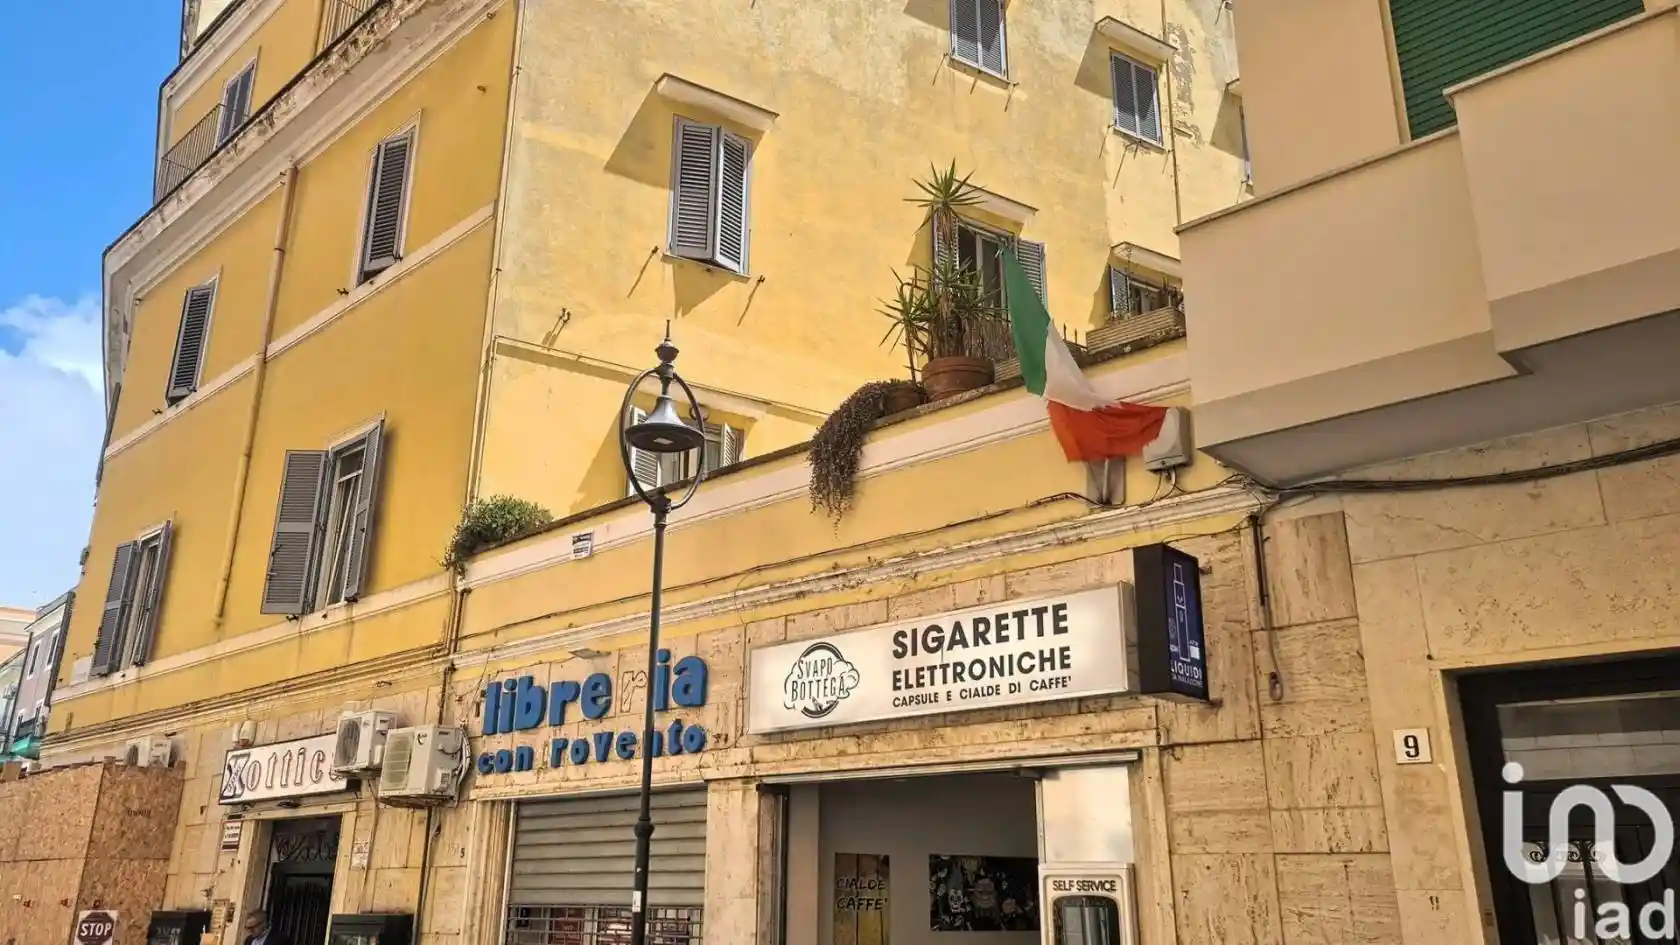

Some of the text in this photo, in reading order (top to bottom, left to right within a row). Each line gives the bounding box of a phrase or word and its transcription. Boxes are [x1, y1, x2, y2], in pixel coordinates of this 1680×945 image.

[892, 602, 1068, 659] SIGARETTE
[797, 657, 833, 680] SVAPO
[892, 646, 1071, 691] ELETTRONICHE
[1170, 660, 1202, 680] LIQUIDI
[791, 676, 846, 701] BOTTEGA
[892, 675, 1072, 708] CAPSULE E CIALDE DI CAFFE'
[1403, 734, 1420, 758] 9
[477, 745, 535, 775] con
[836, 878, 886, 890] CIALDE
[1052, 879, 1118, 893] SELF SERVICE
[836, 896, 888, 911] CAFFE'
[79, 921, 113, 937] STOP
